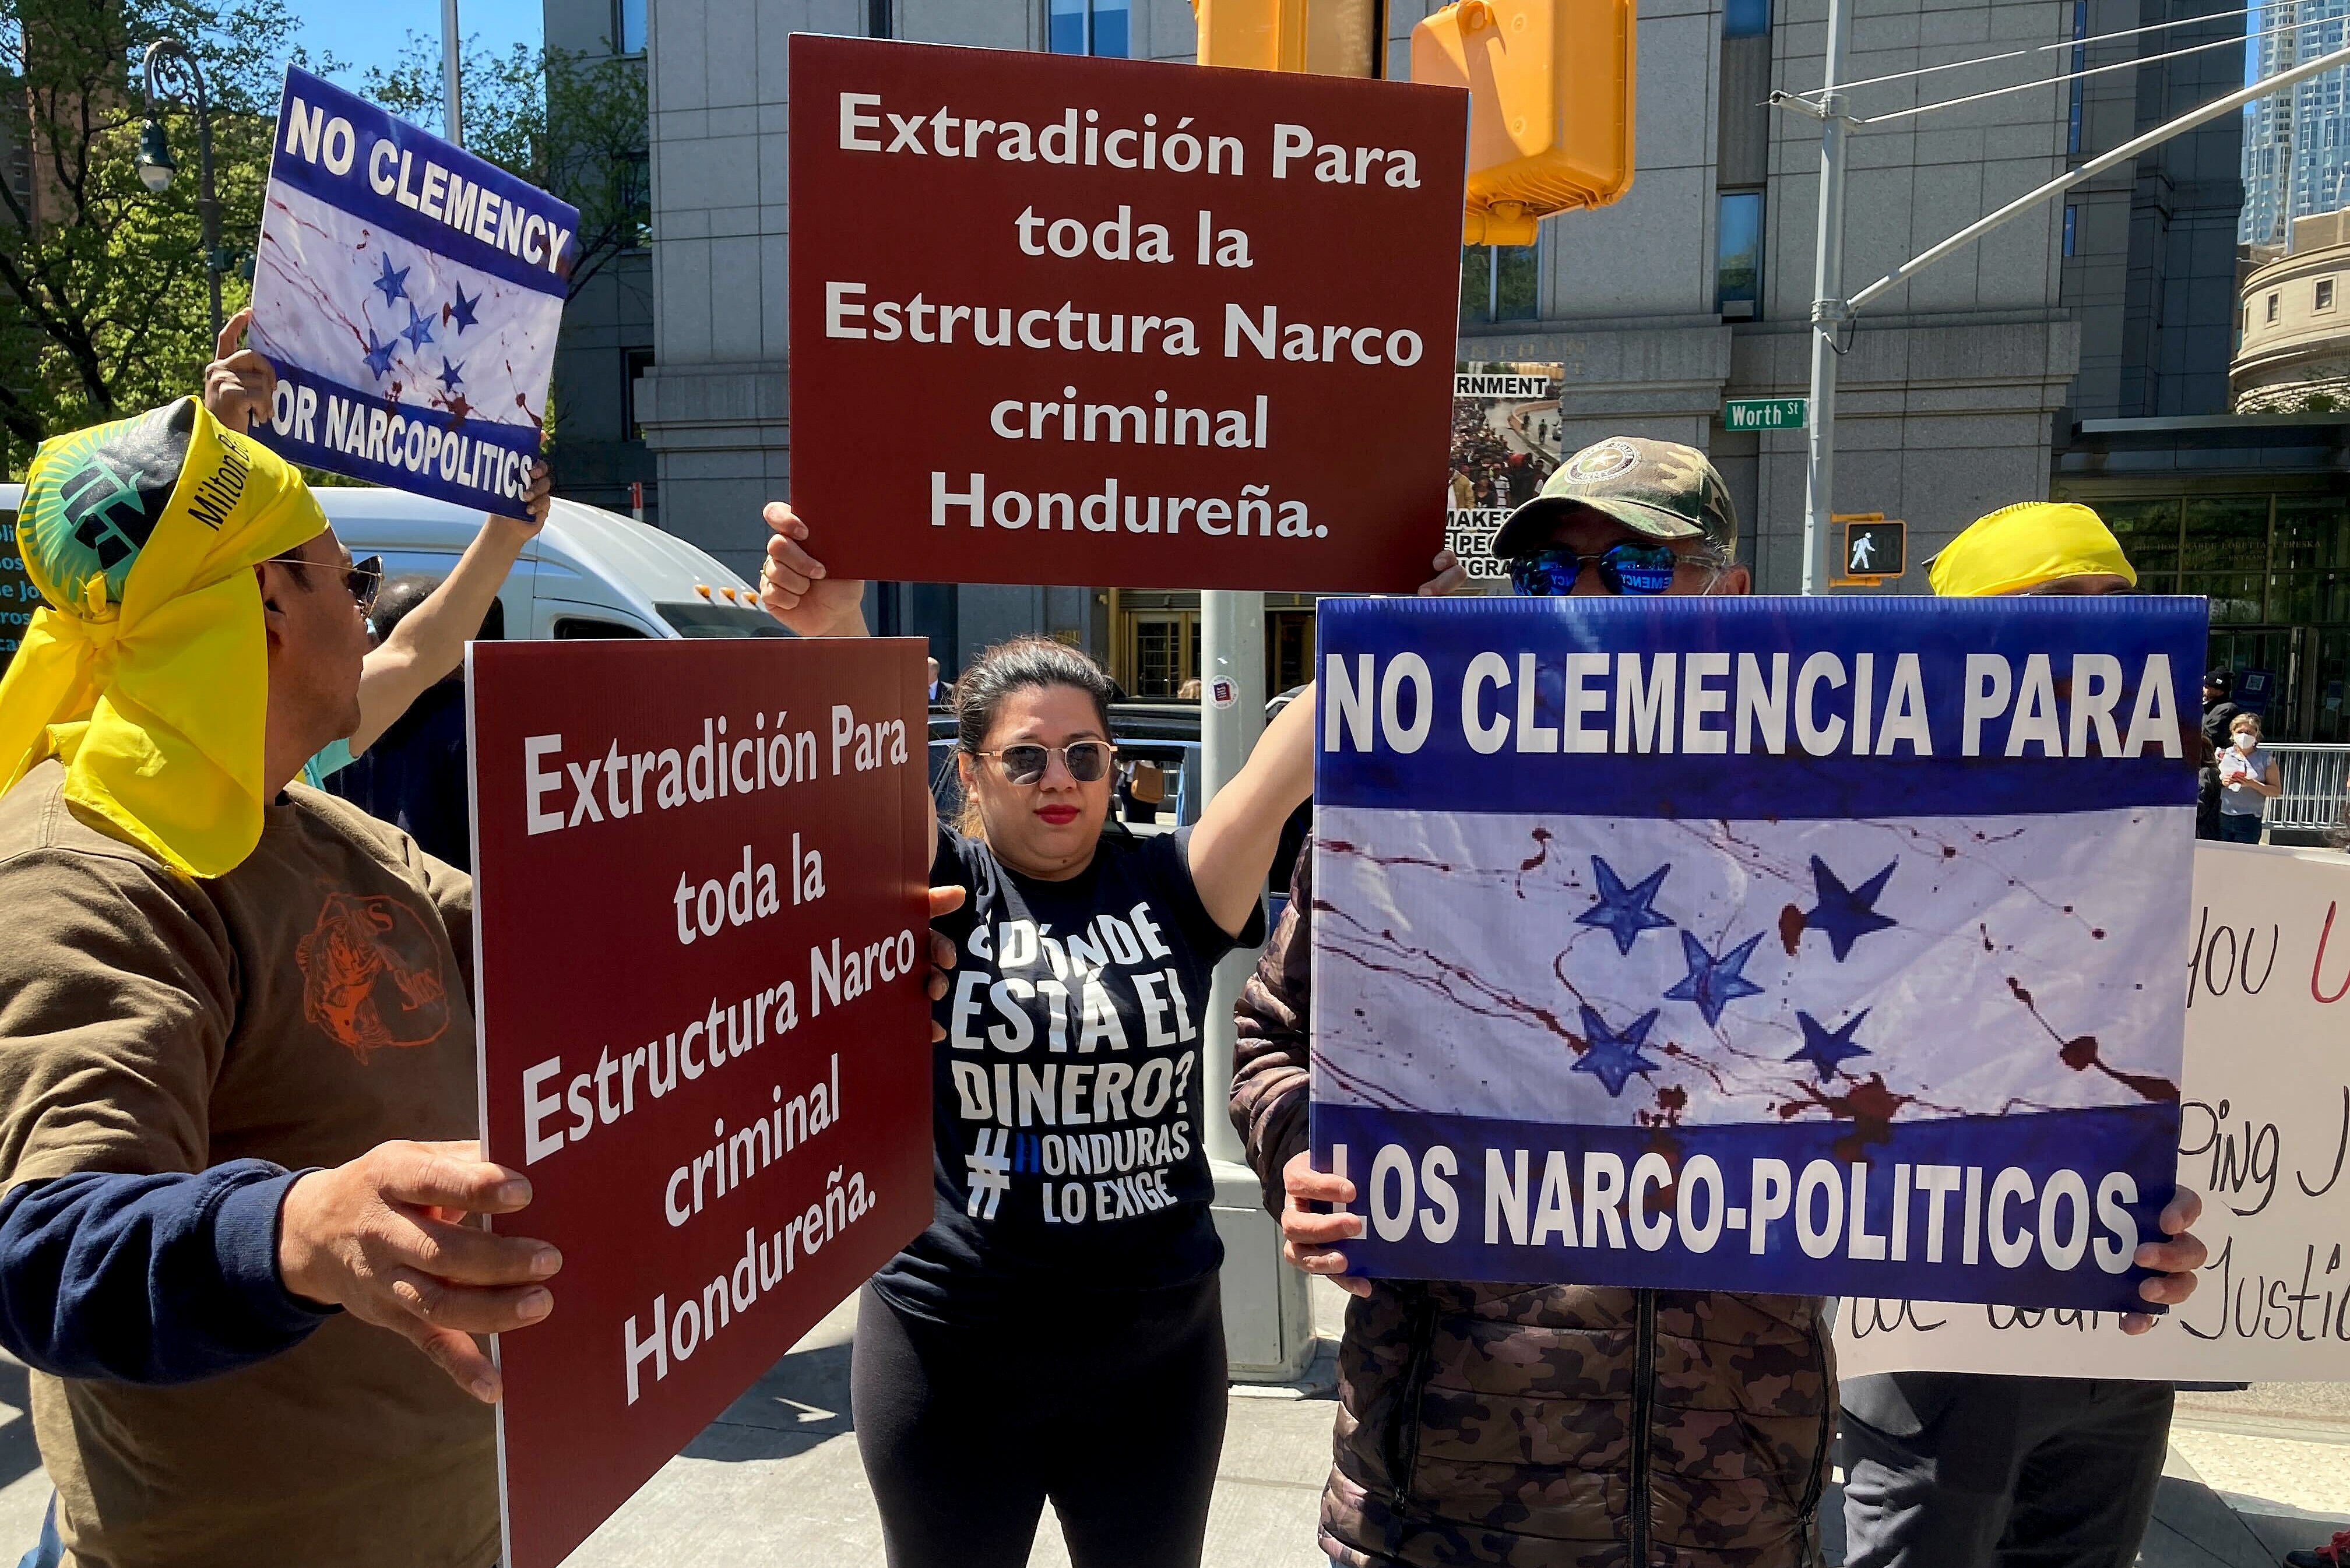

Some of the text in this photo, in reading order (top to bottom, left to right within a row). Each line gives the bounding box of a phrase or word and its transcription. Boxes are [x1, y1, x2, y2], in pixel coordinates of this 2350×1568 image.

[839, 92, 1421, 188] Extradición Para
[286, 96, 570, 273] NO CLEMENCY
[1015, 205, 1253, 267] toda la
[826, 282, 1423, 367] Estructura Narco
[990, 385, 1268, 448] criminal
[1457, 377, 1547, 394] RNMENT
[1732, 402, 1798, 426] Worth St
[253, 379, 532, 502] OR NARCOPOLITICS
[188, 455, 249, 531] Milton
[931, 471, 1328, 538] Hondureña.
[1459, 535, 1492, 551] PE
[1325, 650, 2183, 759] NO CLEMENCIA PARA
[525, 704, 908, 836] Extradición Para
[673, 833, 825, 945] toda la
[522, 929, 914, 1167] Estructura Narco
[951, 967, 1197, 1053] ESTÁ EL
[951, 1050, 1195, 1127] DINERO?
[664, 1052, 839, 1228] criminal
[1043, 1168, 1178, 1223] LO EXIGE
[1484, 1148, 2139, 1276] NARCO-POLITICOS
[624, 1164, 877, 1406] Hondureña.
